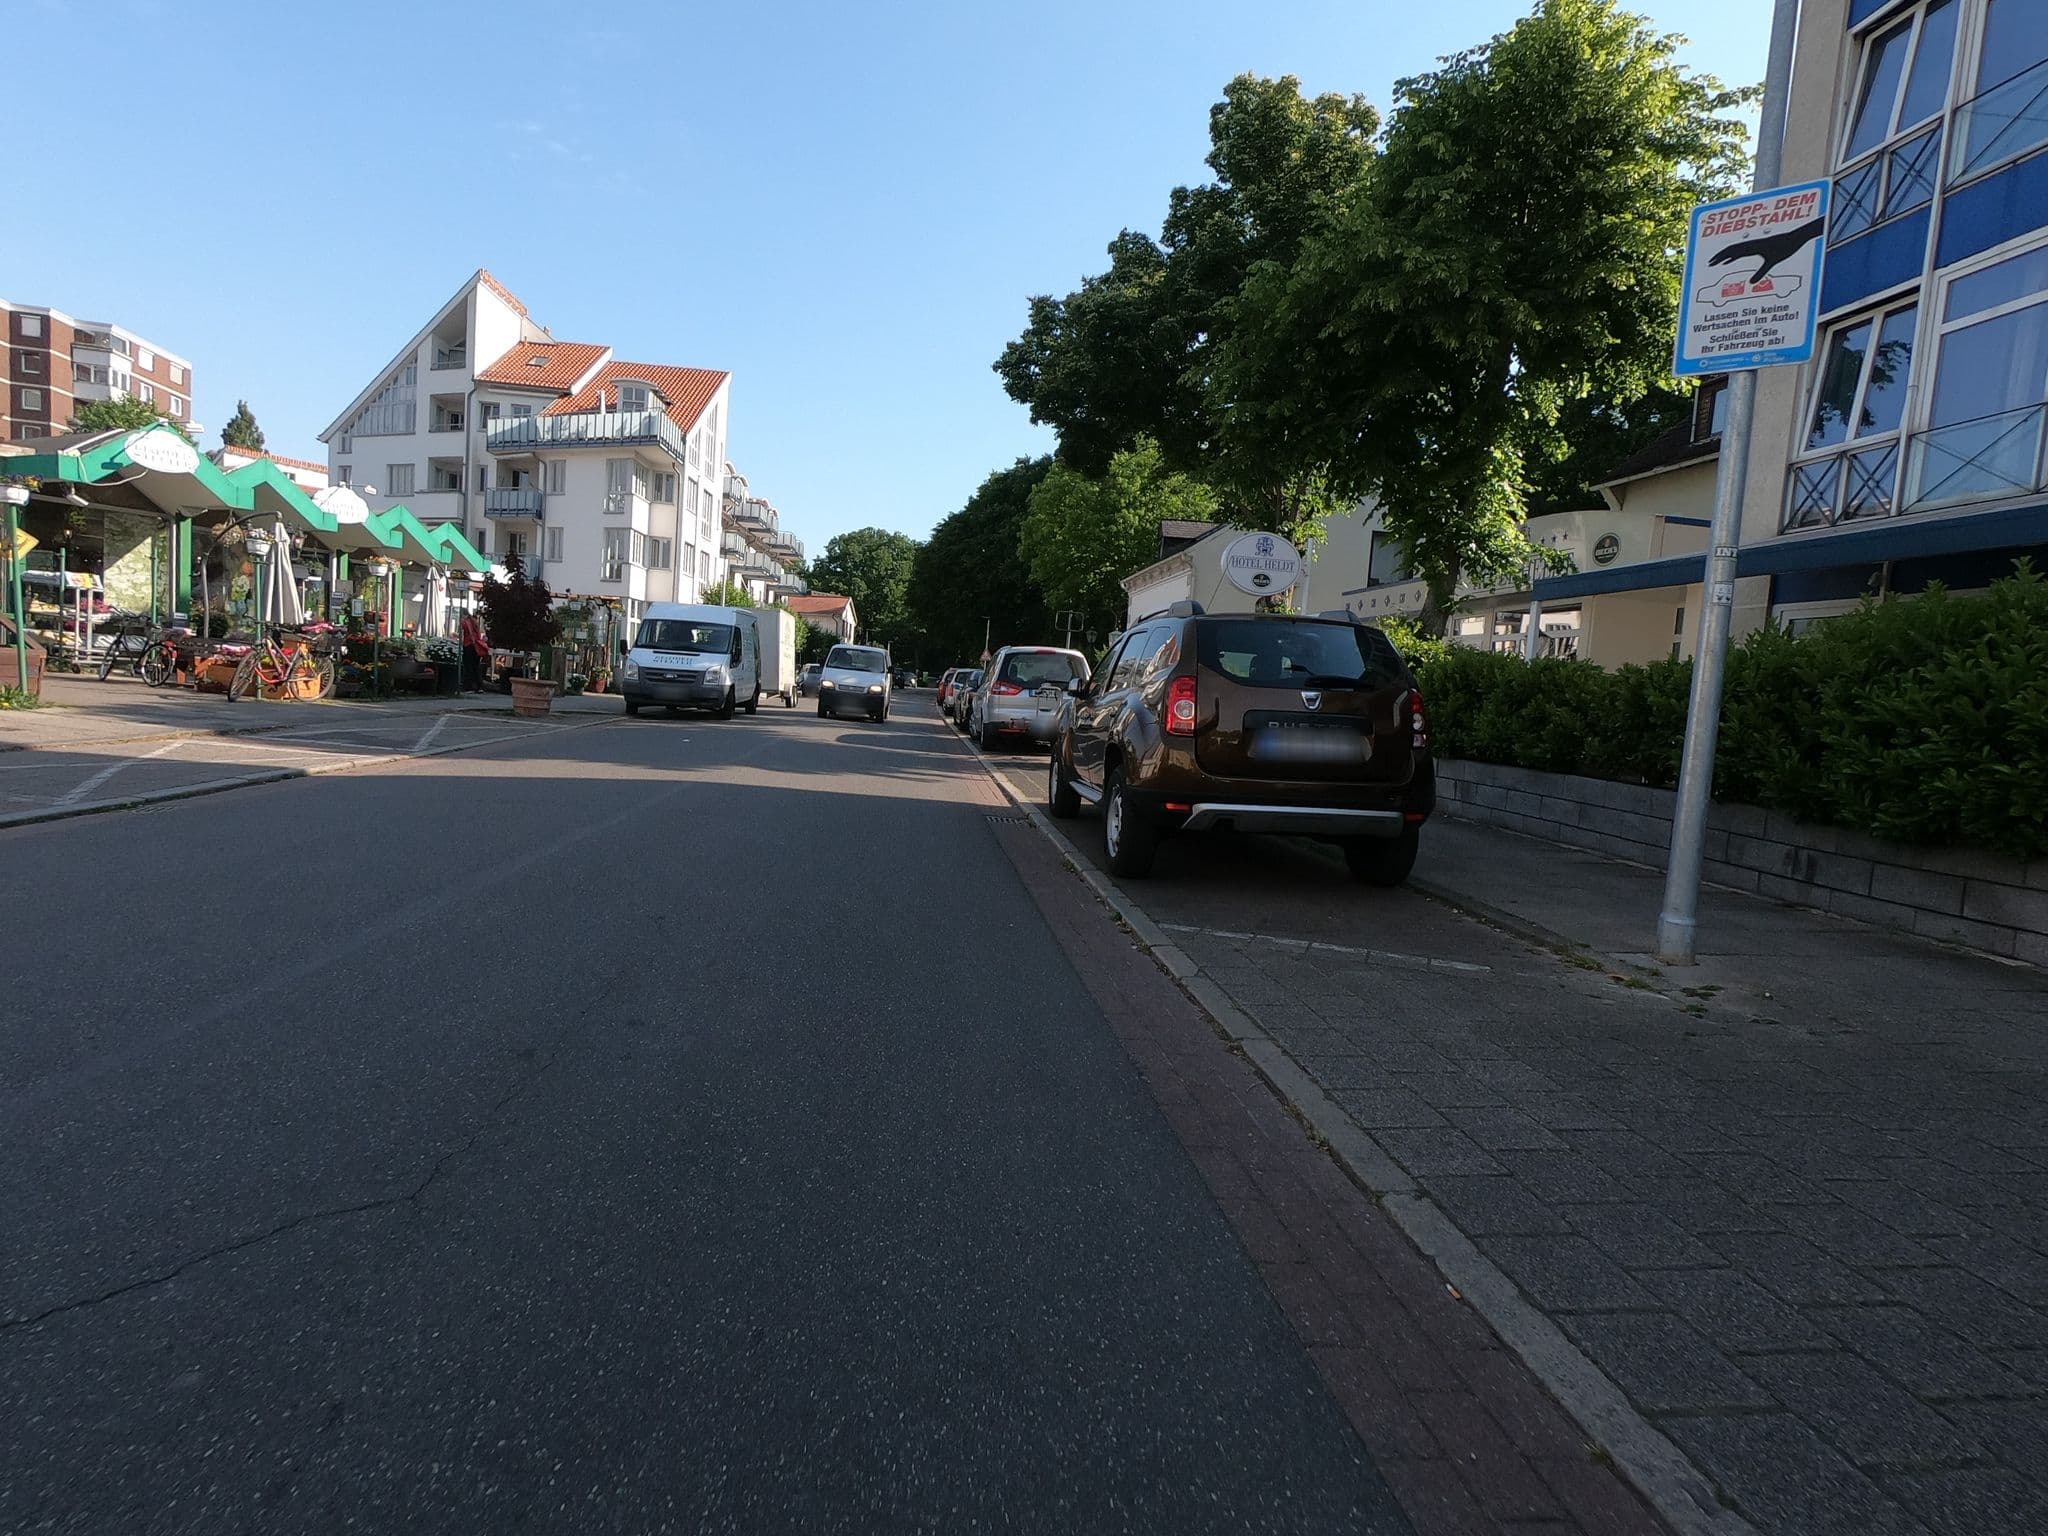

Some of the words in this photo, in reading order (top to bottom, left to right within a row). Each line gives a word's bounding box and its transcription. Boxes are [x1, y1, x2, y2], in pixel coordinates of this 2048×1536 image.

[1774, 191, 1818, 211] DEM
[1702, 205, 1813, 238] DIEBSTAHL!
[1693, 319, 1751, 333] Wertsachen
[1754, 315, 1767, 324] im
[1770, 311, 1799, 322] Auto!
[1704, 311, 1739, 323] Lassen
[1741, 307, 1758, 317] Sie
[1760, 304, 1790, 314] keine
[1701, 345, 1715, 354] Ihr
[1718, 339, 1765, 352] Fahrzeug
[1767, 336, 1785, 346] ab!
[1709, 330, 1759, 344] Schließen
[1762, 328, 1778, 337] Sie
[1231, 557, 1262, 569] HOTEL
[1264, 560, 1296, 571] HELDT
